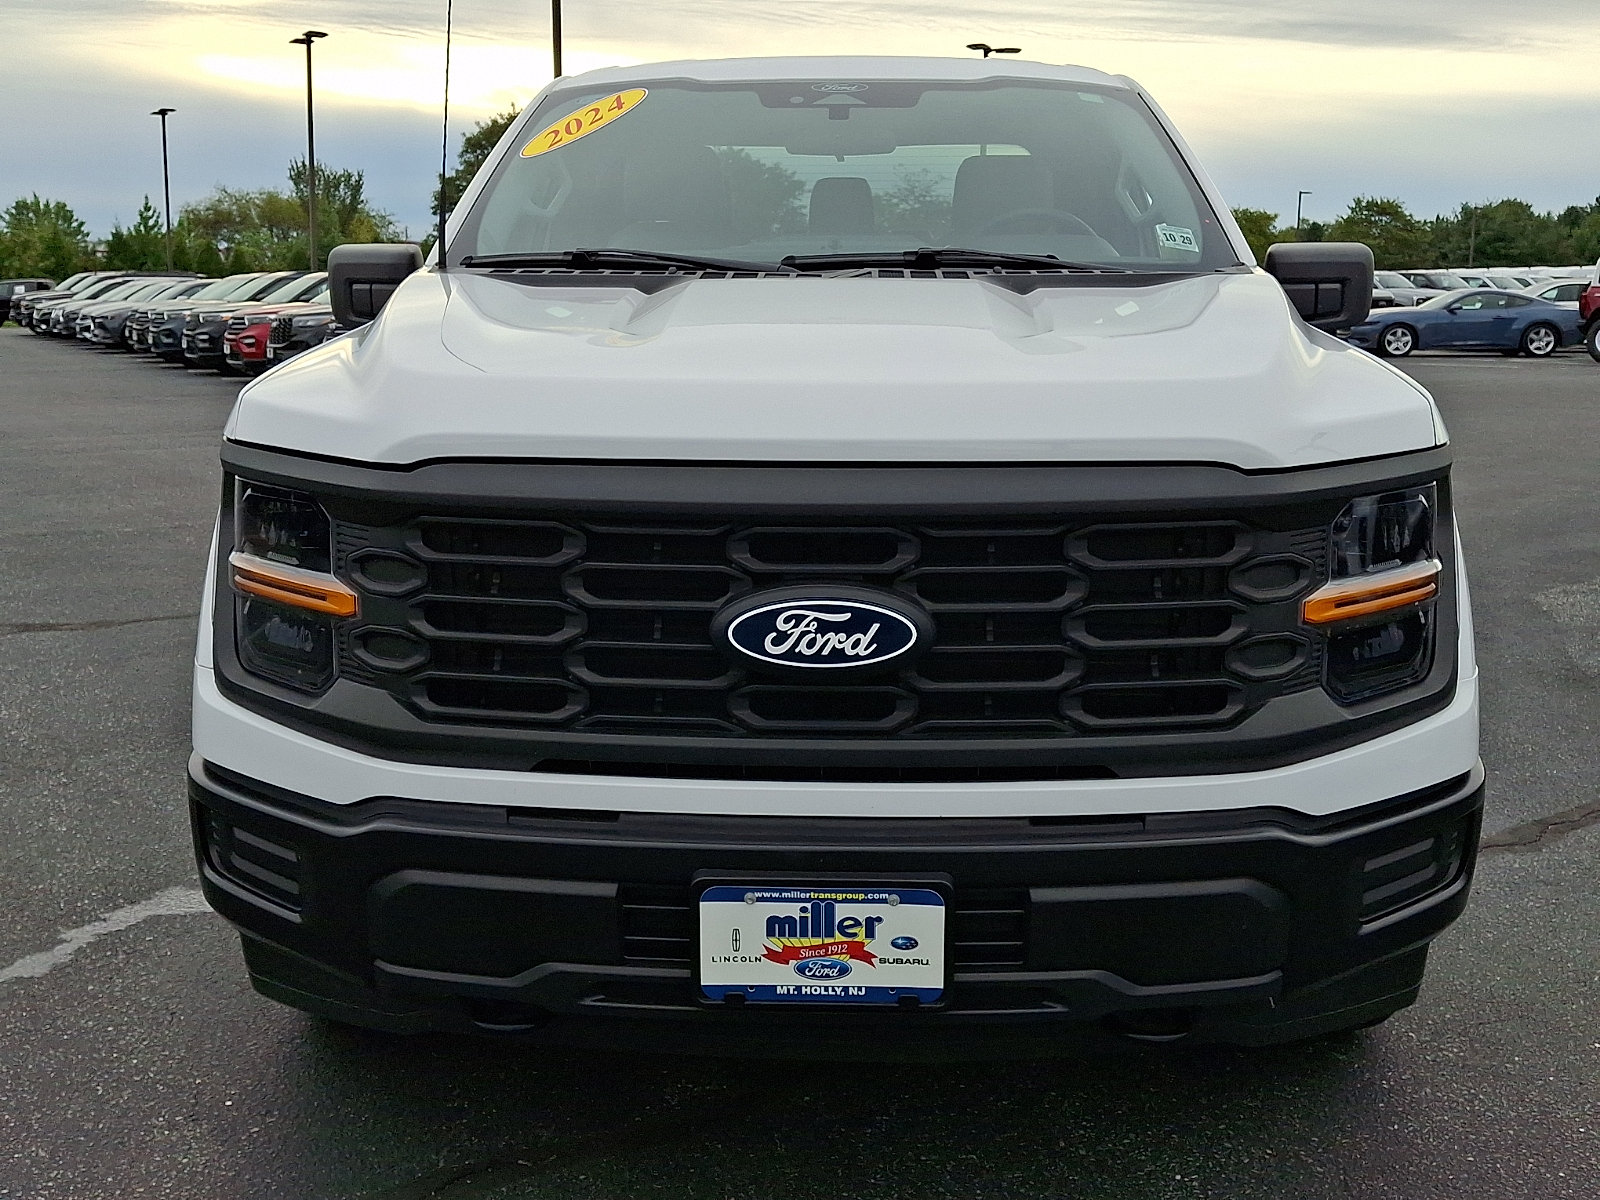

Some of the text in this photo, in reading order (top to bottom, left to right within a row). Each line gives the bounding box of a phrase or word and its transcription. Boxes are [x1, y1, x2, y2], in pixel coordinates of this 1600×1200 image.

[821, 83, 859, 91] Ford
[544, 95, 625, 148] 2024
[1163, 233, 1176, 242] 10
[1180, 235, 1192, 245] 29
[764, 609, 881, 656] Ford
[754, 891, 889, 901] www.millertransgroup.com
[765, 900, 885, 939] miller
[799, 944, 848, 958] Since 1912
[878, 957, 930, 966] SUBARU
[805, 960, 840, 977] Ford
[776, 986, 866, 997] MT. HOLLY, NJ
